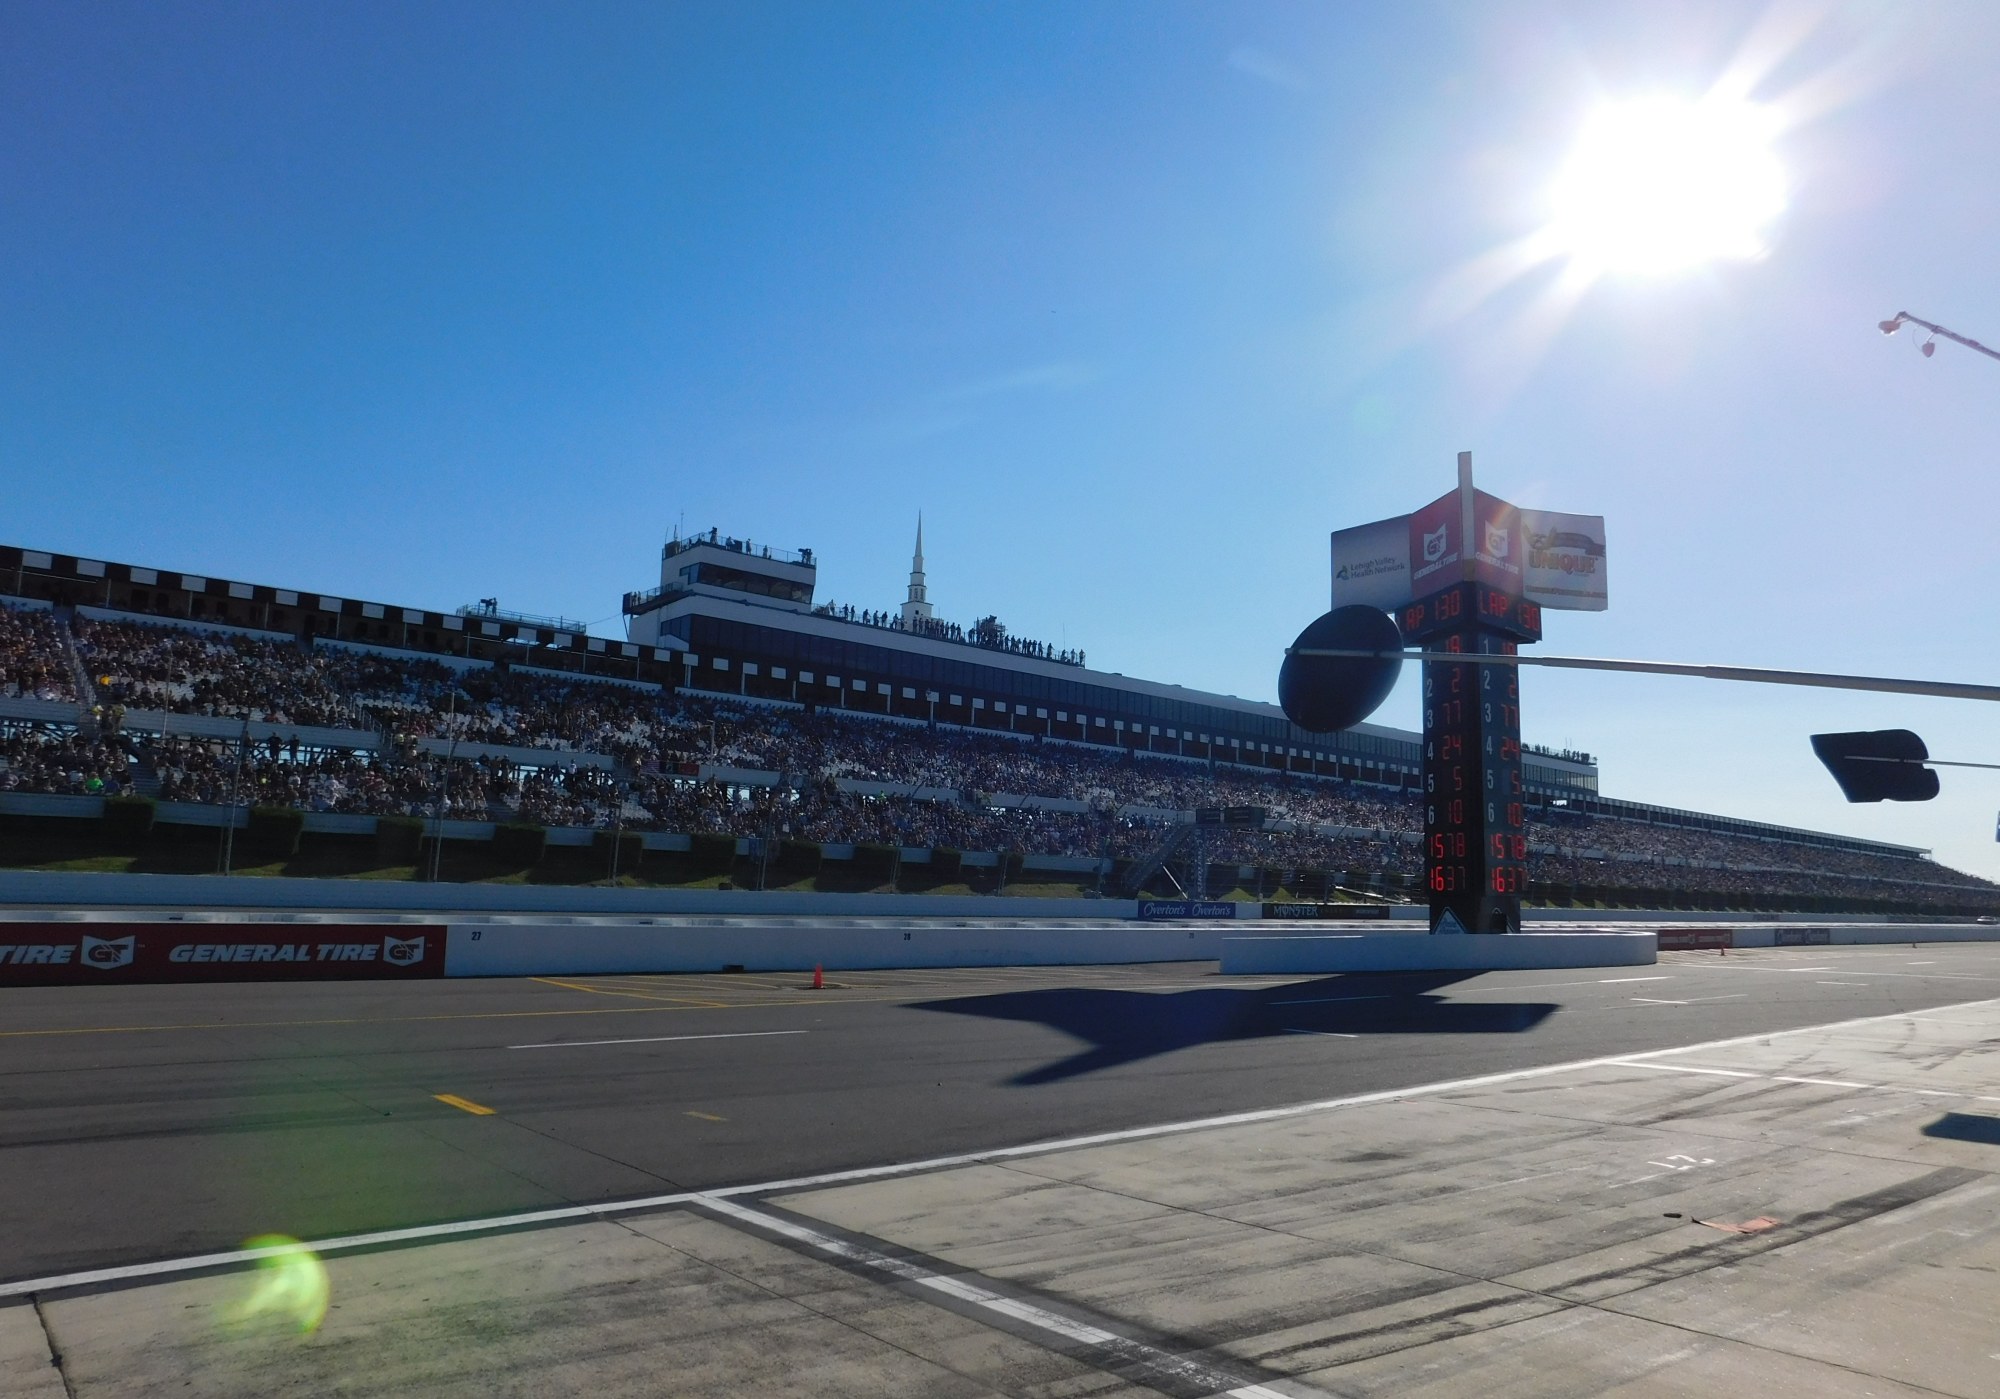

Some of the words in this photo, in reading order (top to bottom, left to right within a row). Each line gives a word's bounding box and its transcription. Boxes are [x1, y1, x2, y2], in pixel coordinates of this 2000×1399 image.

[1350, 559, 1375, 572] Lehigh
[1375, 556, 1396, 567] Valley
[1350, 566, 1374, 579] Health
[1375, 562, 1405, 576] Network
[1475, 552, 1504, 570] GENERAL
[1528, 550, 1594, 575] UNIQUE
[1434, 590, 1461, 622] 130
[1478, 590, 1508, 619] LAP
[1517, 604, 1539, 632] 130
[1426, 679, 1433, 698] 2
[1451, 667, 1460, 693] 2
[1484, 670, 1490, 690] 2
[1507, 674, 1516, 699] 2
[1427, 709, 1434, 729] 3
[1442, 700, 1462, 725] 77
[1485, 703, 1492, 723] 3
[1500, 703, 1519, 730] 77
[1427, 742, 1434, 761] 4
[1441, 735, 1462, 760] 24
[1486, 736, 1493, 755] 4
[1500, 736, 1520, 761] 24
[1428, 773, 1434, 793] 5
[1453, 766, 1463, 791] 5
[1486, 769, 1493, 789] 5
[1511, 769, 1520, 795] 5
[1428, 805, 1435, 825] 6
[1448, 799, 1463, 825] 10
[1488, 803, 1494, 822] 6
[1507, 802, 1521, 828] 10
[1143, 902, 1186, 917] Overton's
[1191, 903, 1231, 917] Overton's
[1273, 904, 1319, 918] MONSTER
[471, 931, 482, 941] 27
[0, 943, 78, 965] TIRE
[168, 943, 312, 963] GENERAL
[315, 943, 381, 962] TIRE
